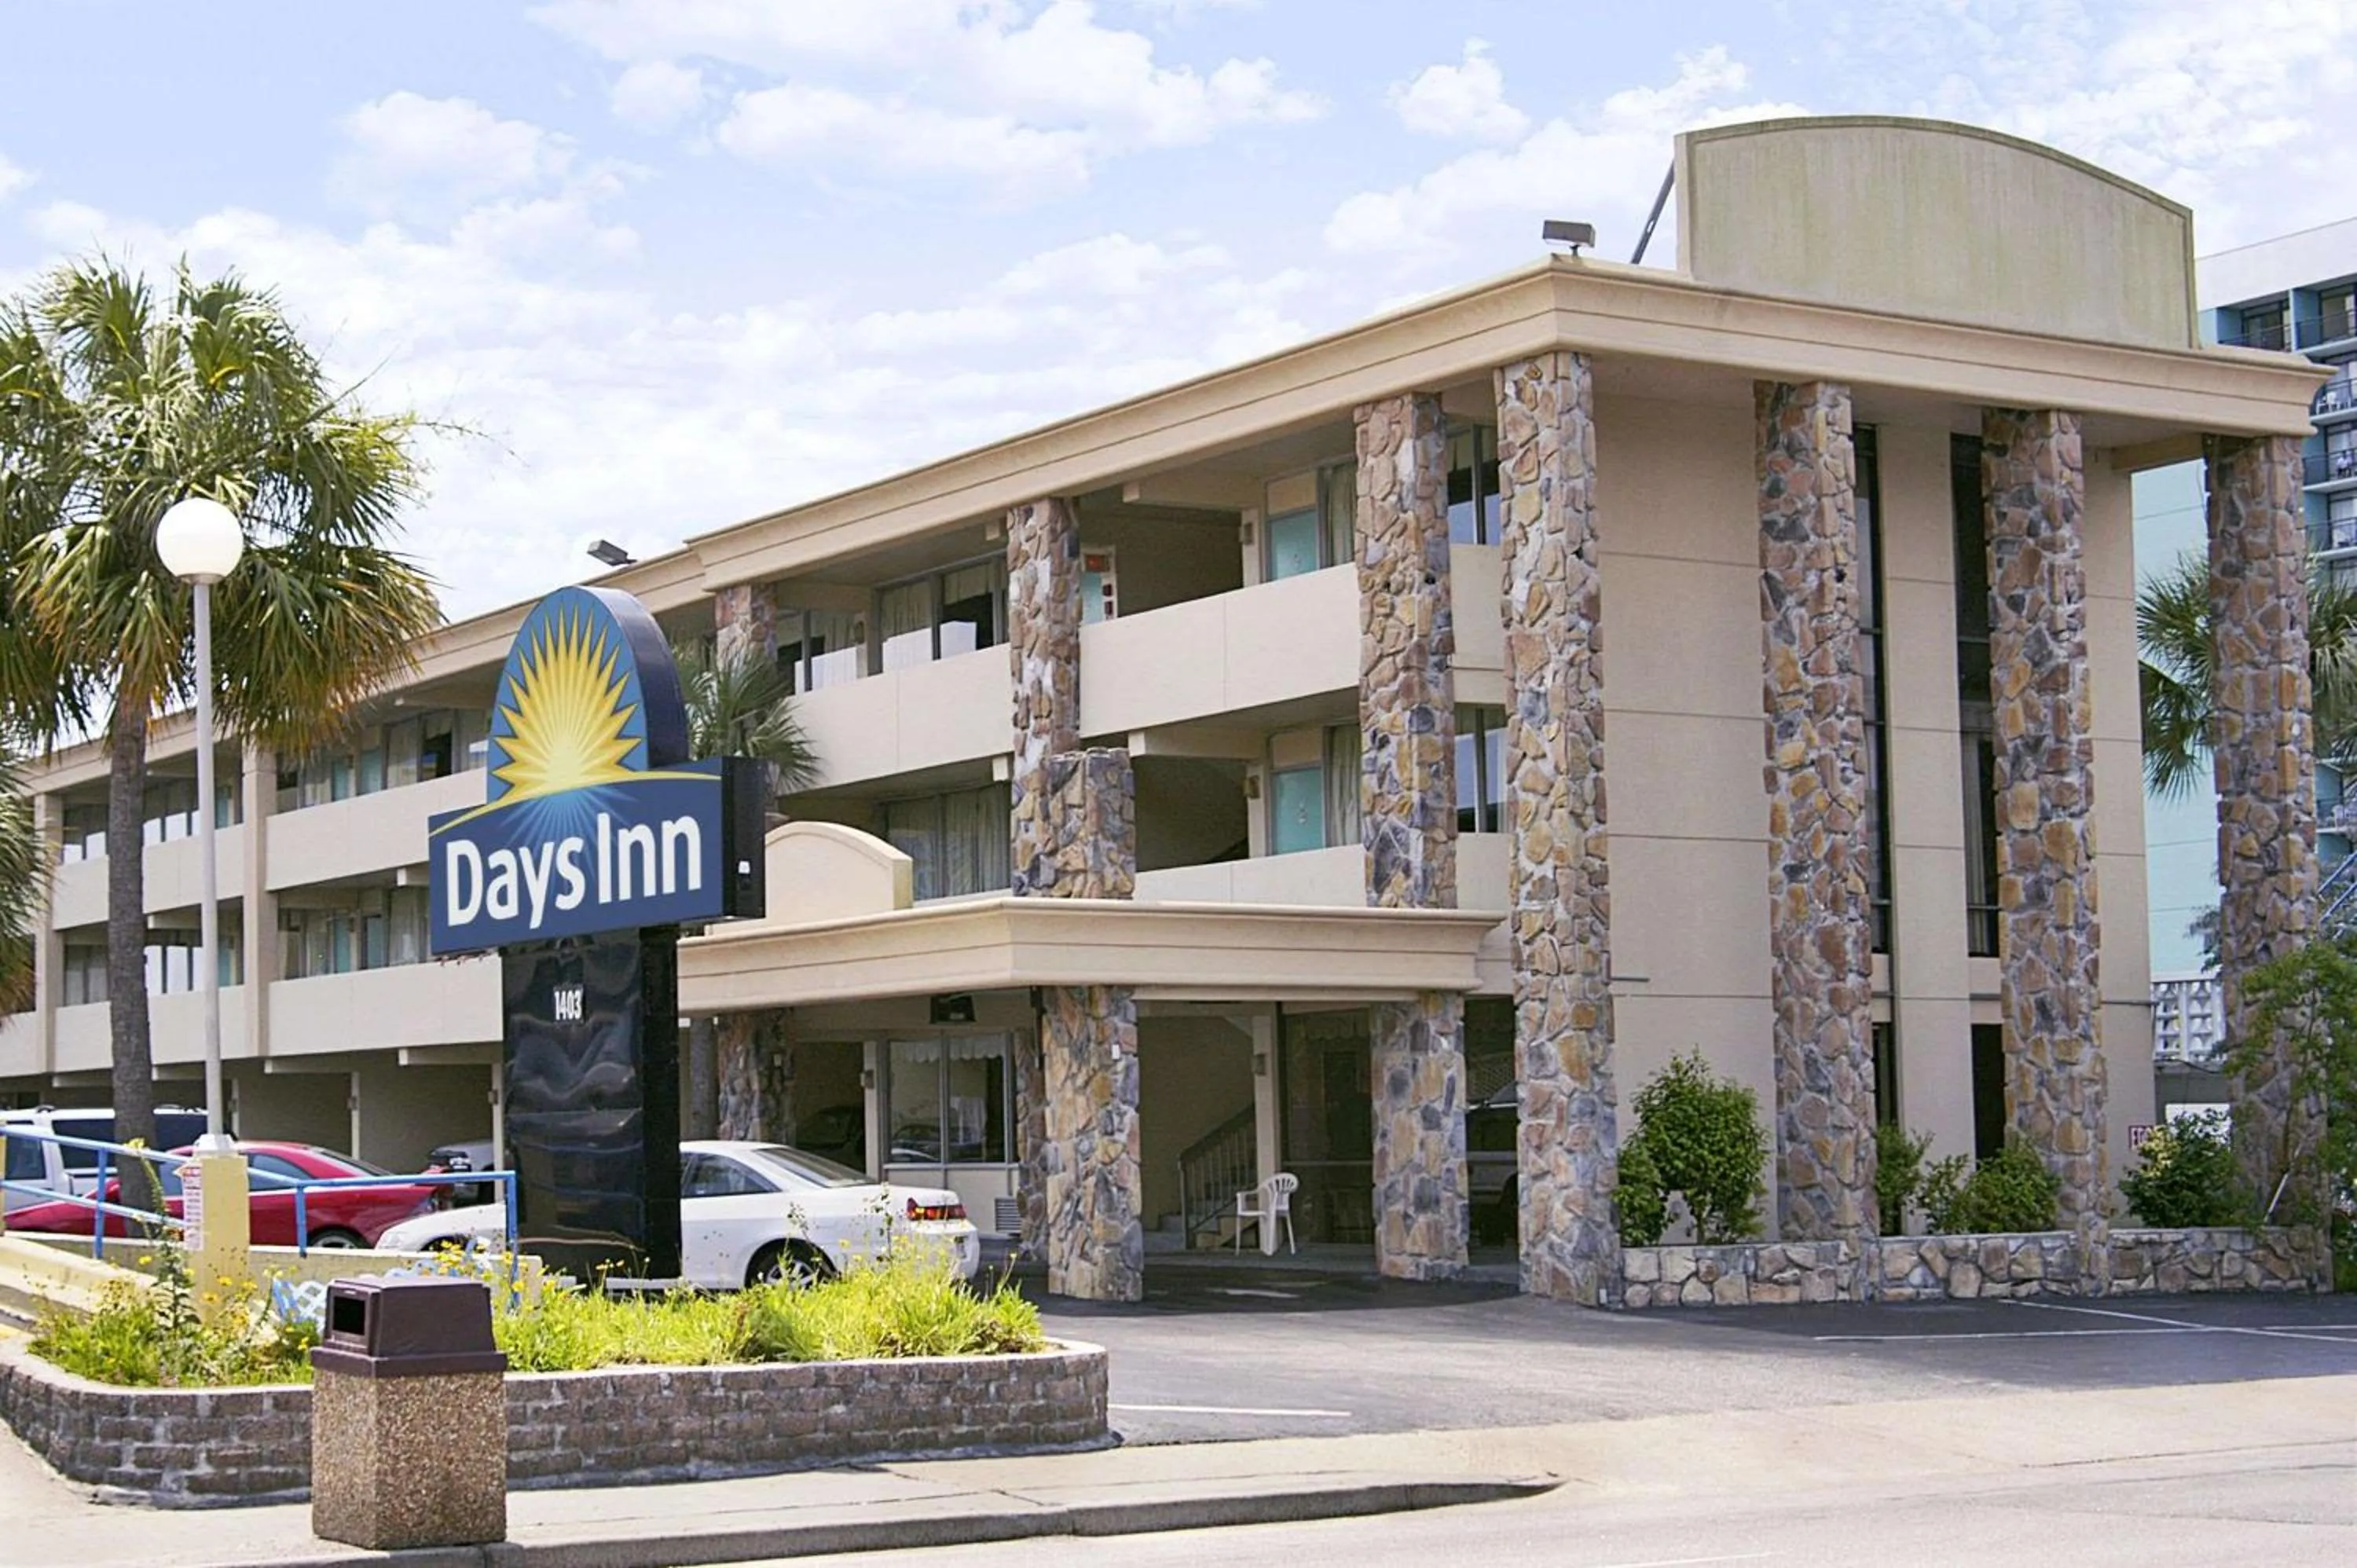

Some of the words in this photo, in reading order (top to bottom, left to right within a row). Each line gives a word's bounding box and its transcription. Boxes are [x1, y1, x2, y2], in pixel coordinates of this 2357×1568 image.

[445, 837, 586, 929] Days
[596, 811, 702, 905] Inn
[554, 990, 583, 1020] 1403
